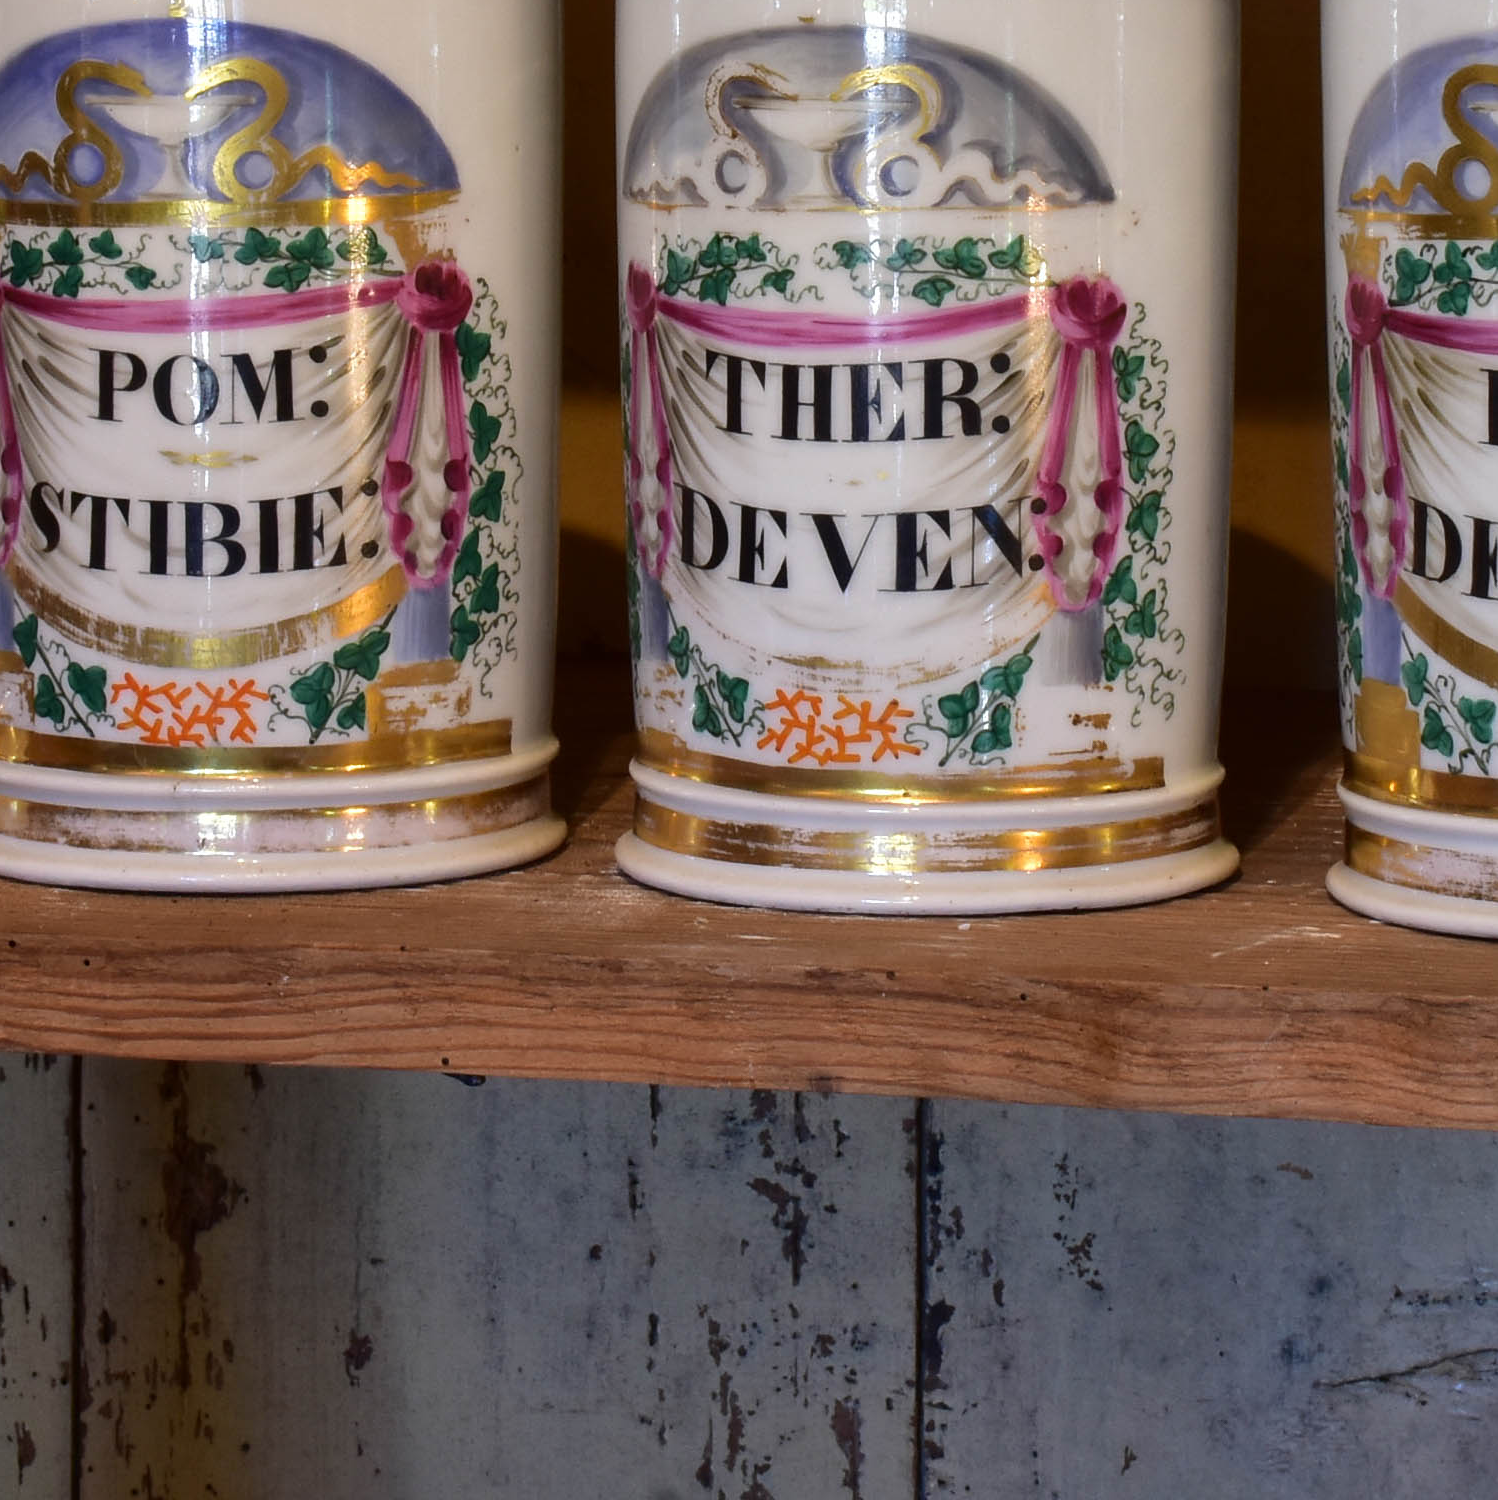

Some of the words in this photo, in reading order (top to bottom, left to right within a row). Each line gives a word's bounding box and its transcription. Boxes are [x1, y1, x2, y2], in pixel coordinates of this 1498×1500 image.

[88, 344, 330, 426] POM:
[705, 350, 1010, 444] THER:
[29, 479, 380, 577] STIBIE:
